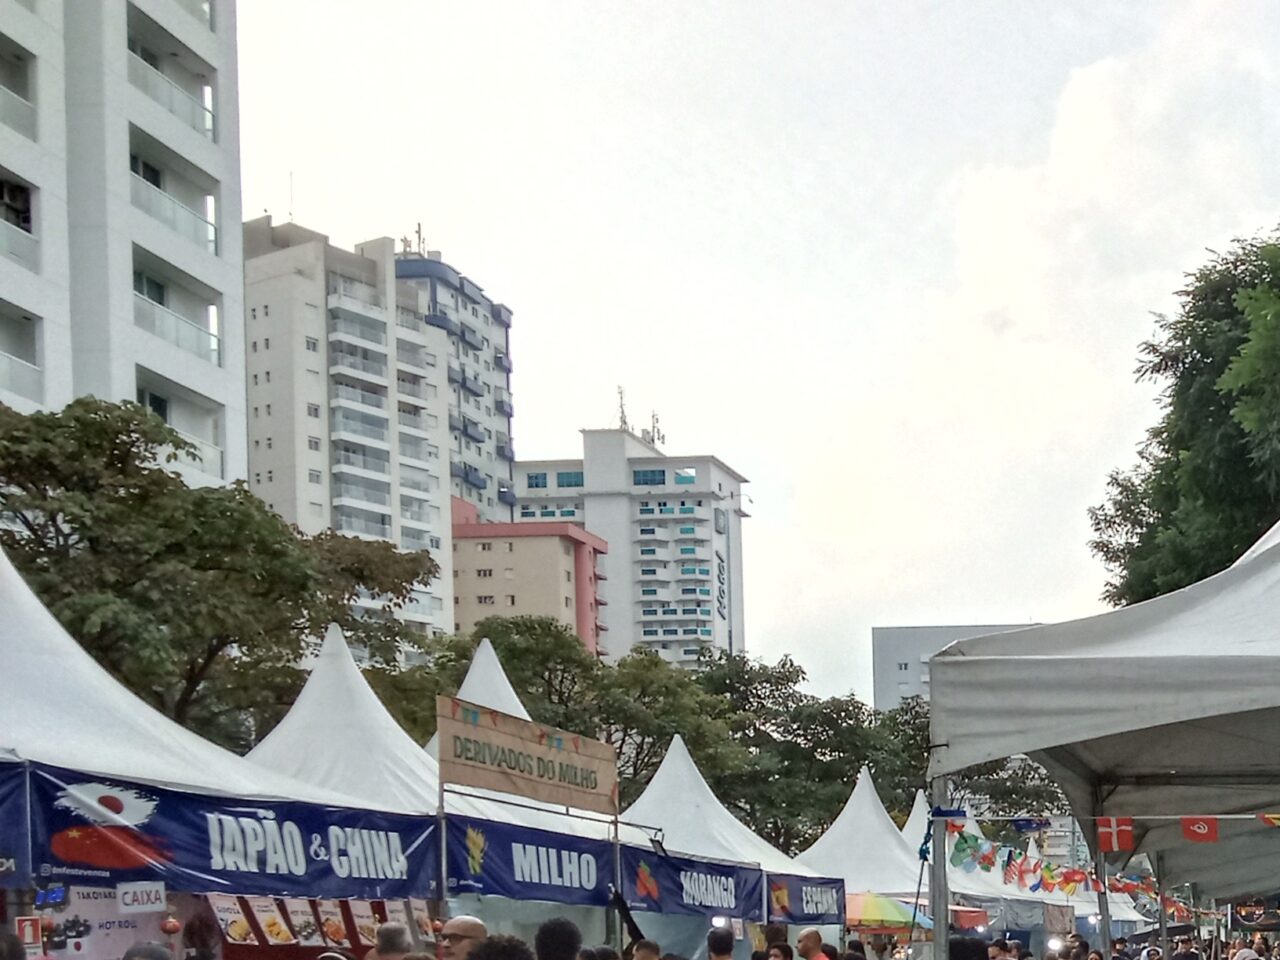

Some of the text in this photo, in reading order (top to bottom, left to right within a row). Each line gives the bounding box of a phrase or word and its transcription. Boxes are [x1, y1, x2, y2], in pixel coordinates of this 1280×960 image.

[715, 550, 726, 621] Hotel
[453, 734, 598, 790] DERIVADOS DO MILHO
[206, 808, 408, 880] JAPÃO & CHINA
[511, 842, 598, 891] MILHO
[122, 889, 162, 906] CAIXA
[680, 870, 736, 909] MORANGO
[802, 886, 839, 915] ESPANHA
[98, 921, 115, 930] HOT
